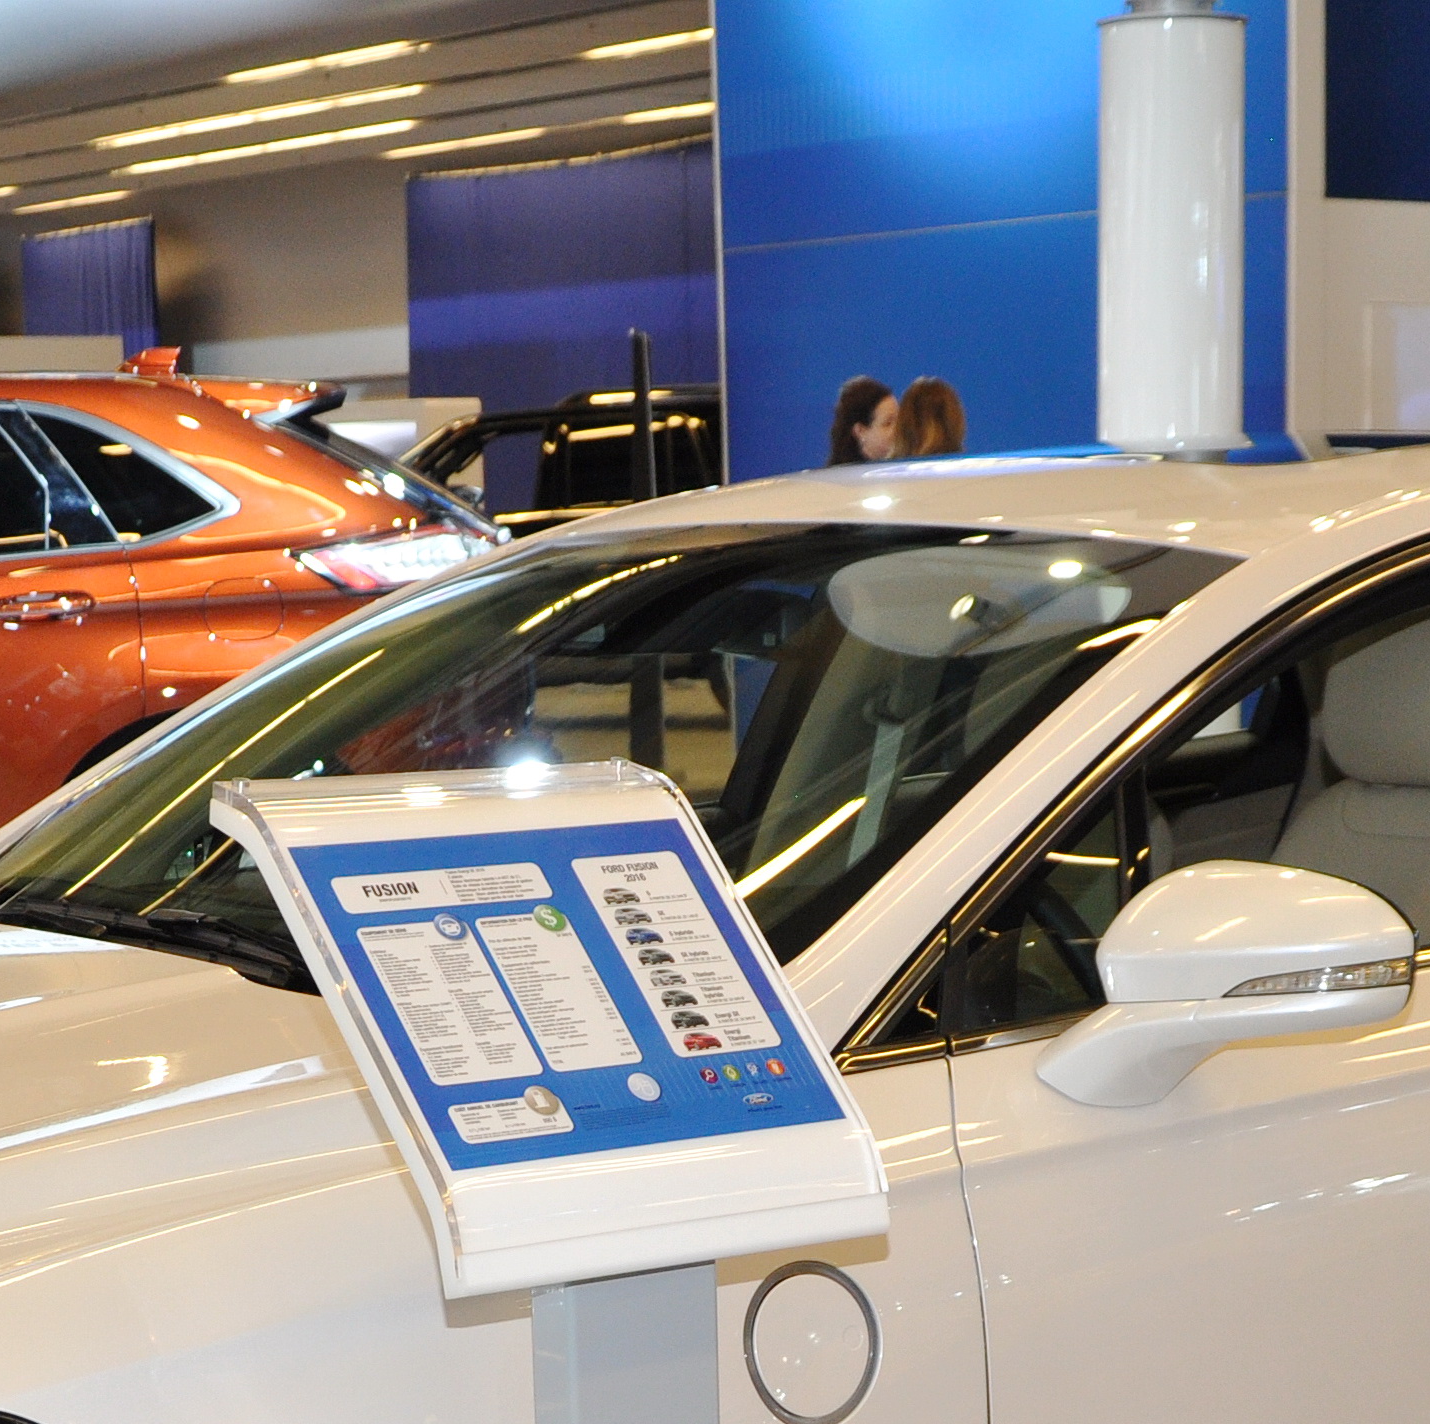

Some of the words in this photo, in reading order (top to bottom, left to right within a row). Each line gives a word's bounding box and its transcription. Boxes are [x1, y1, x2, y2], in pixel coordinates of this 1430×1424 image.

[601, 863, 627, 874] FORD
[627, 861, 659, 872] FUSION
[624, 873, 647, 883] 2016
[361, 881, 420, 898] FUSION
